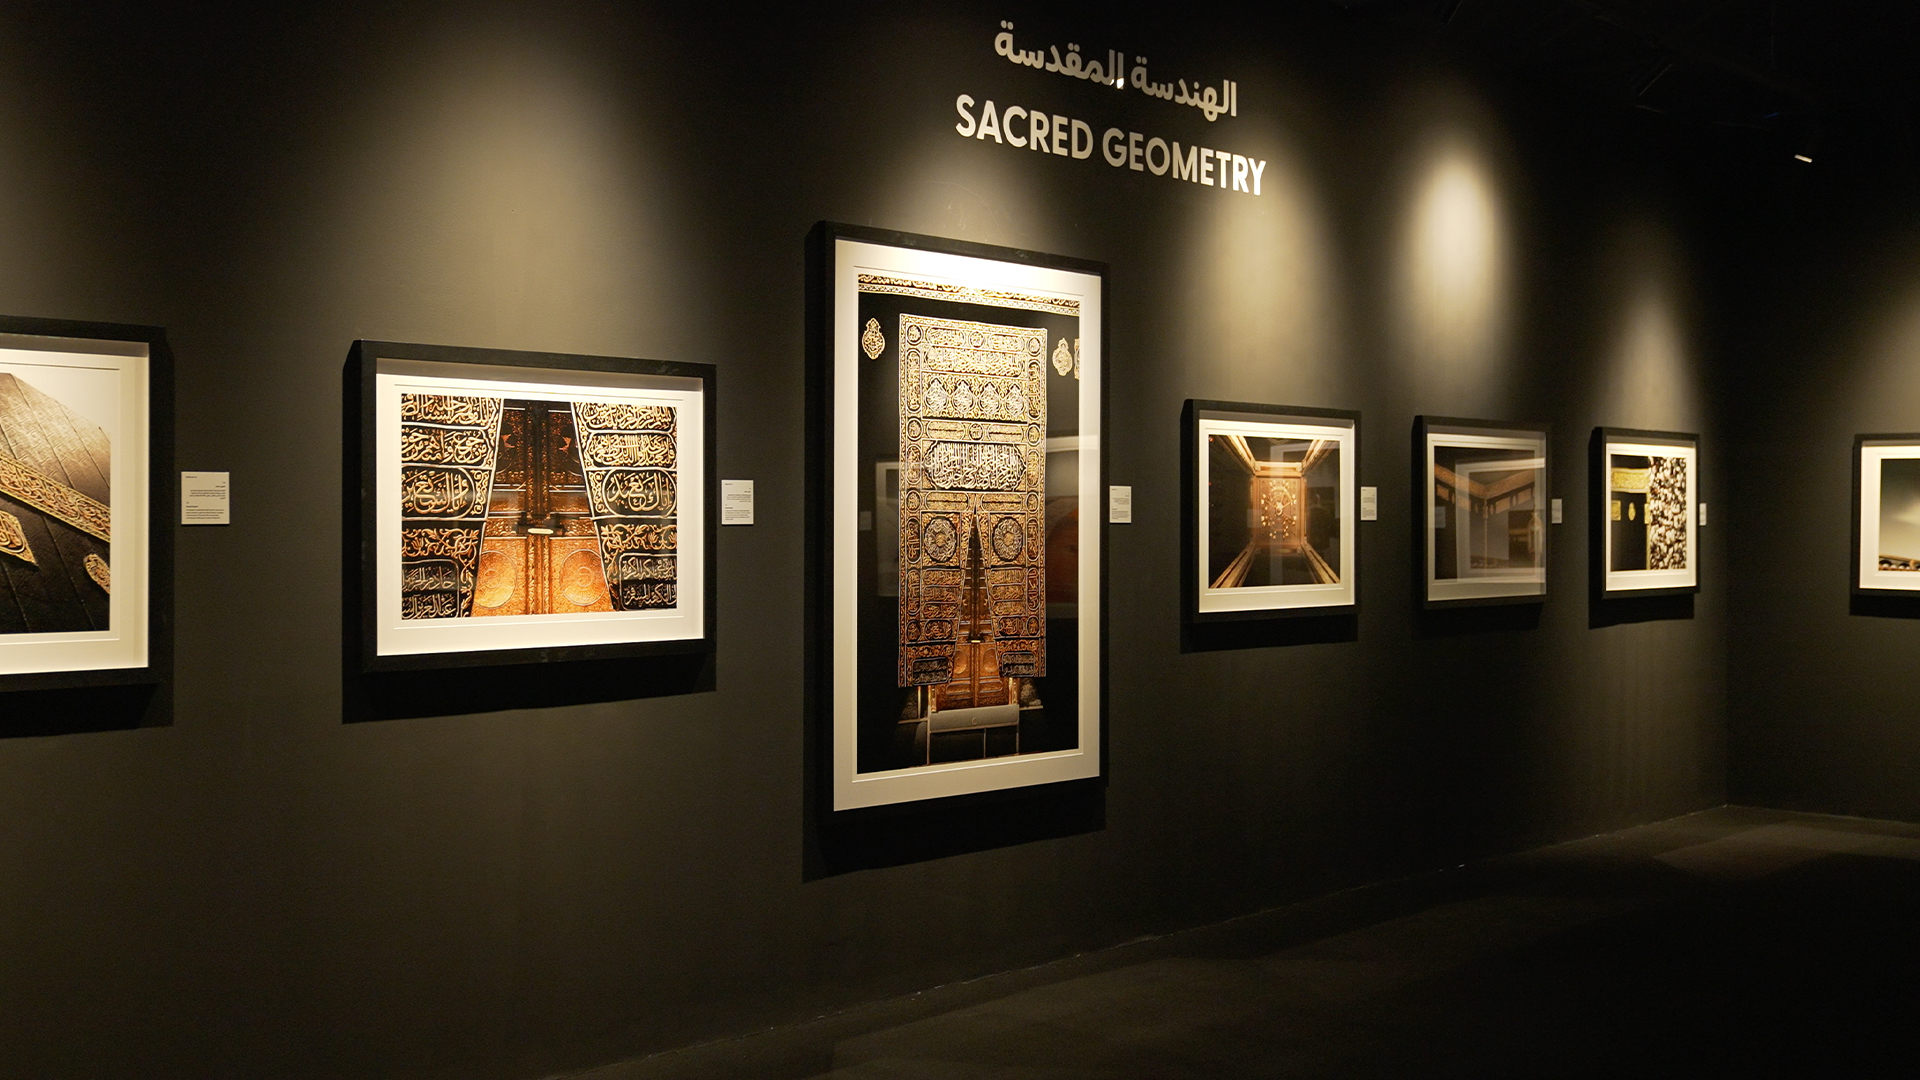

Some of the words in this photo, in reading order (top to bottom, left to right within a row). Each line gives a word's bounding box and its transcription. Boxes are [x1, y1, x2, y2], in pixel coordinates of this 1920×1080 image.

[995, 20, 1124, 90] المقدسة
[1131, 56, 1237, 122] الهندسة
[955, 94, 1094, 160] SACRED
[1102, 127, 1267, 196] GEOMETRY
